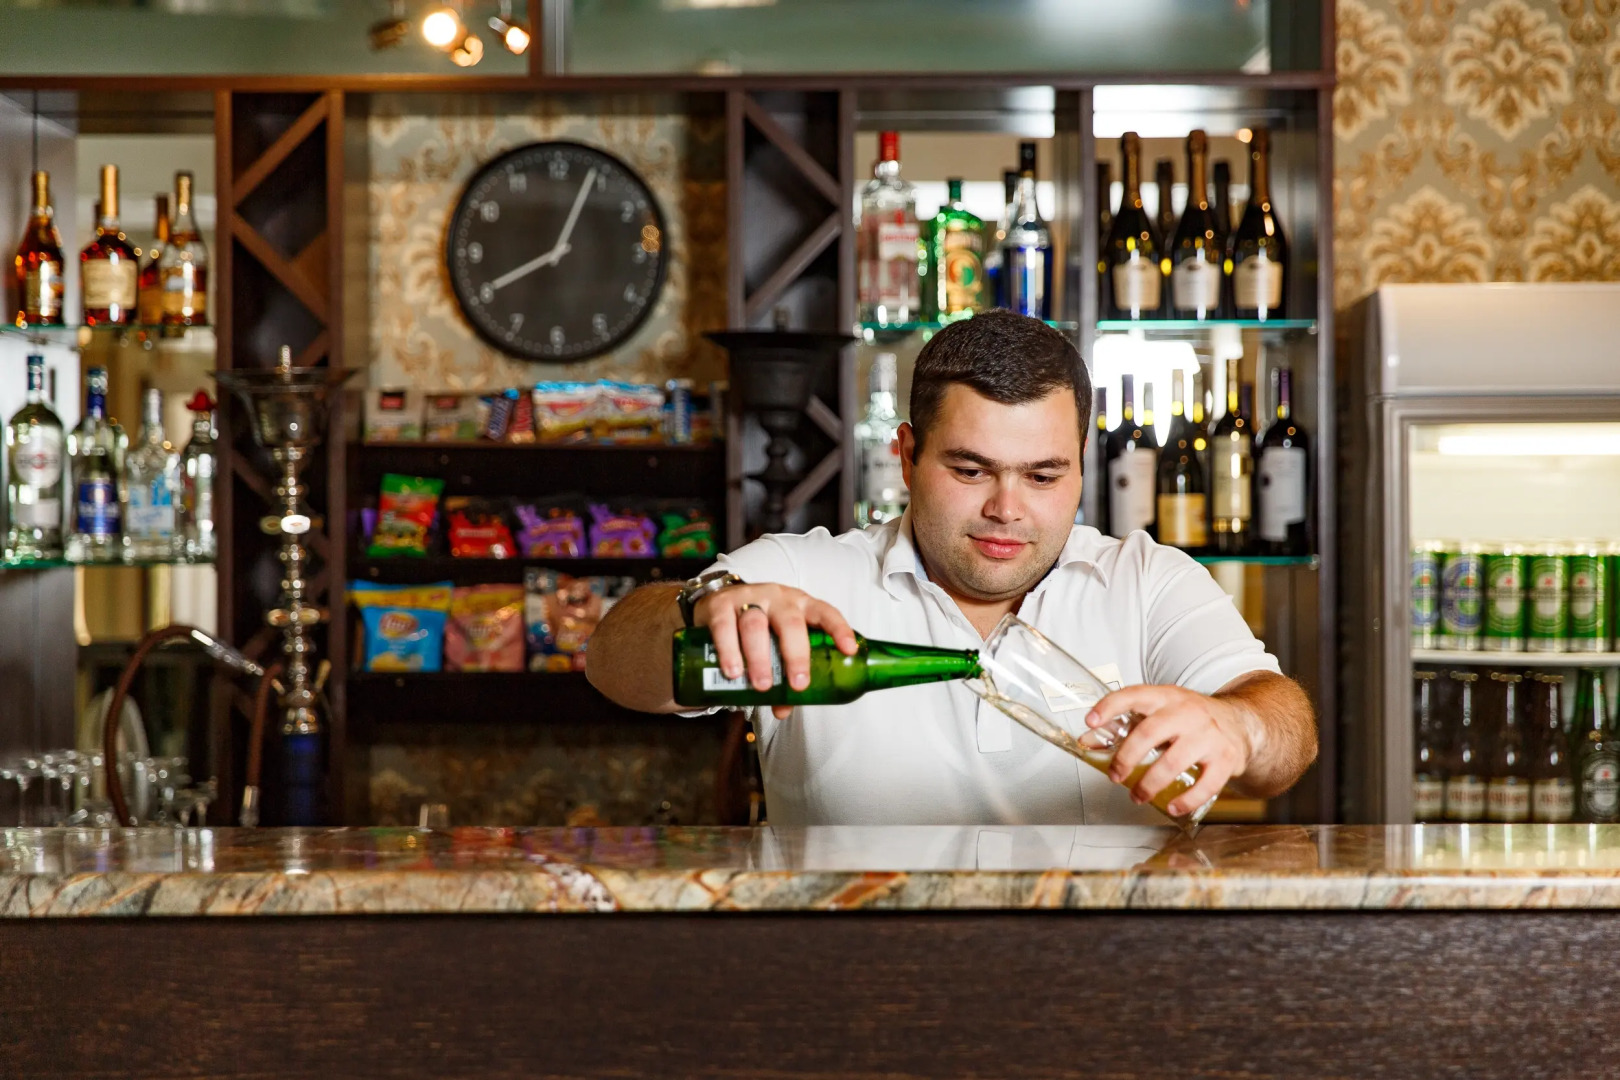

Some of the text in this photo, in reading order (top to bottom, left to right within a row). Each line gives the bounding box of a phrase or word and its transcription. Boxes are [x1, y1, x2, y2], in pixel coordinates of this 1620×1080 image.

[509, 173, 527, 193] 11
[480, 200, 500, 222] 10
[621, 200, 635, 222] 2
[509, 312, 525, 333] 7
